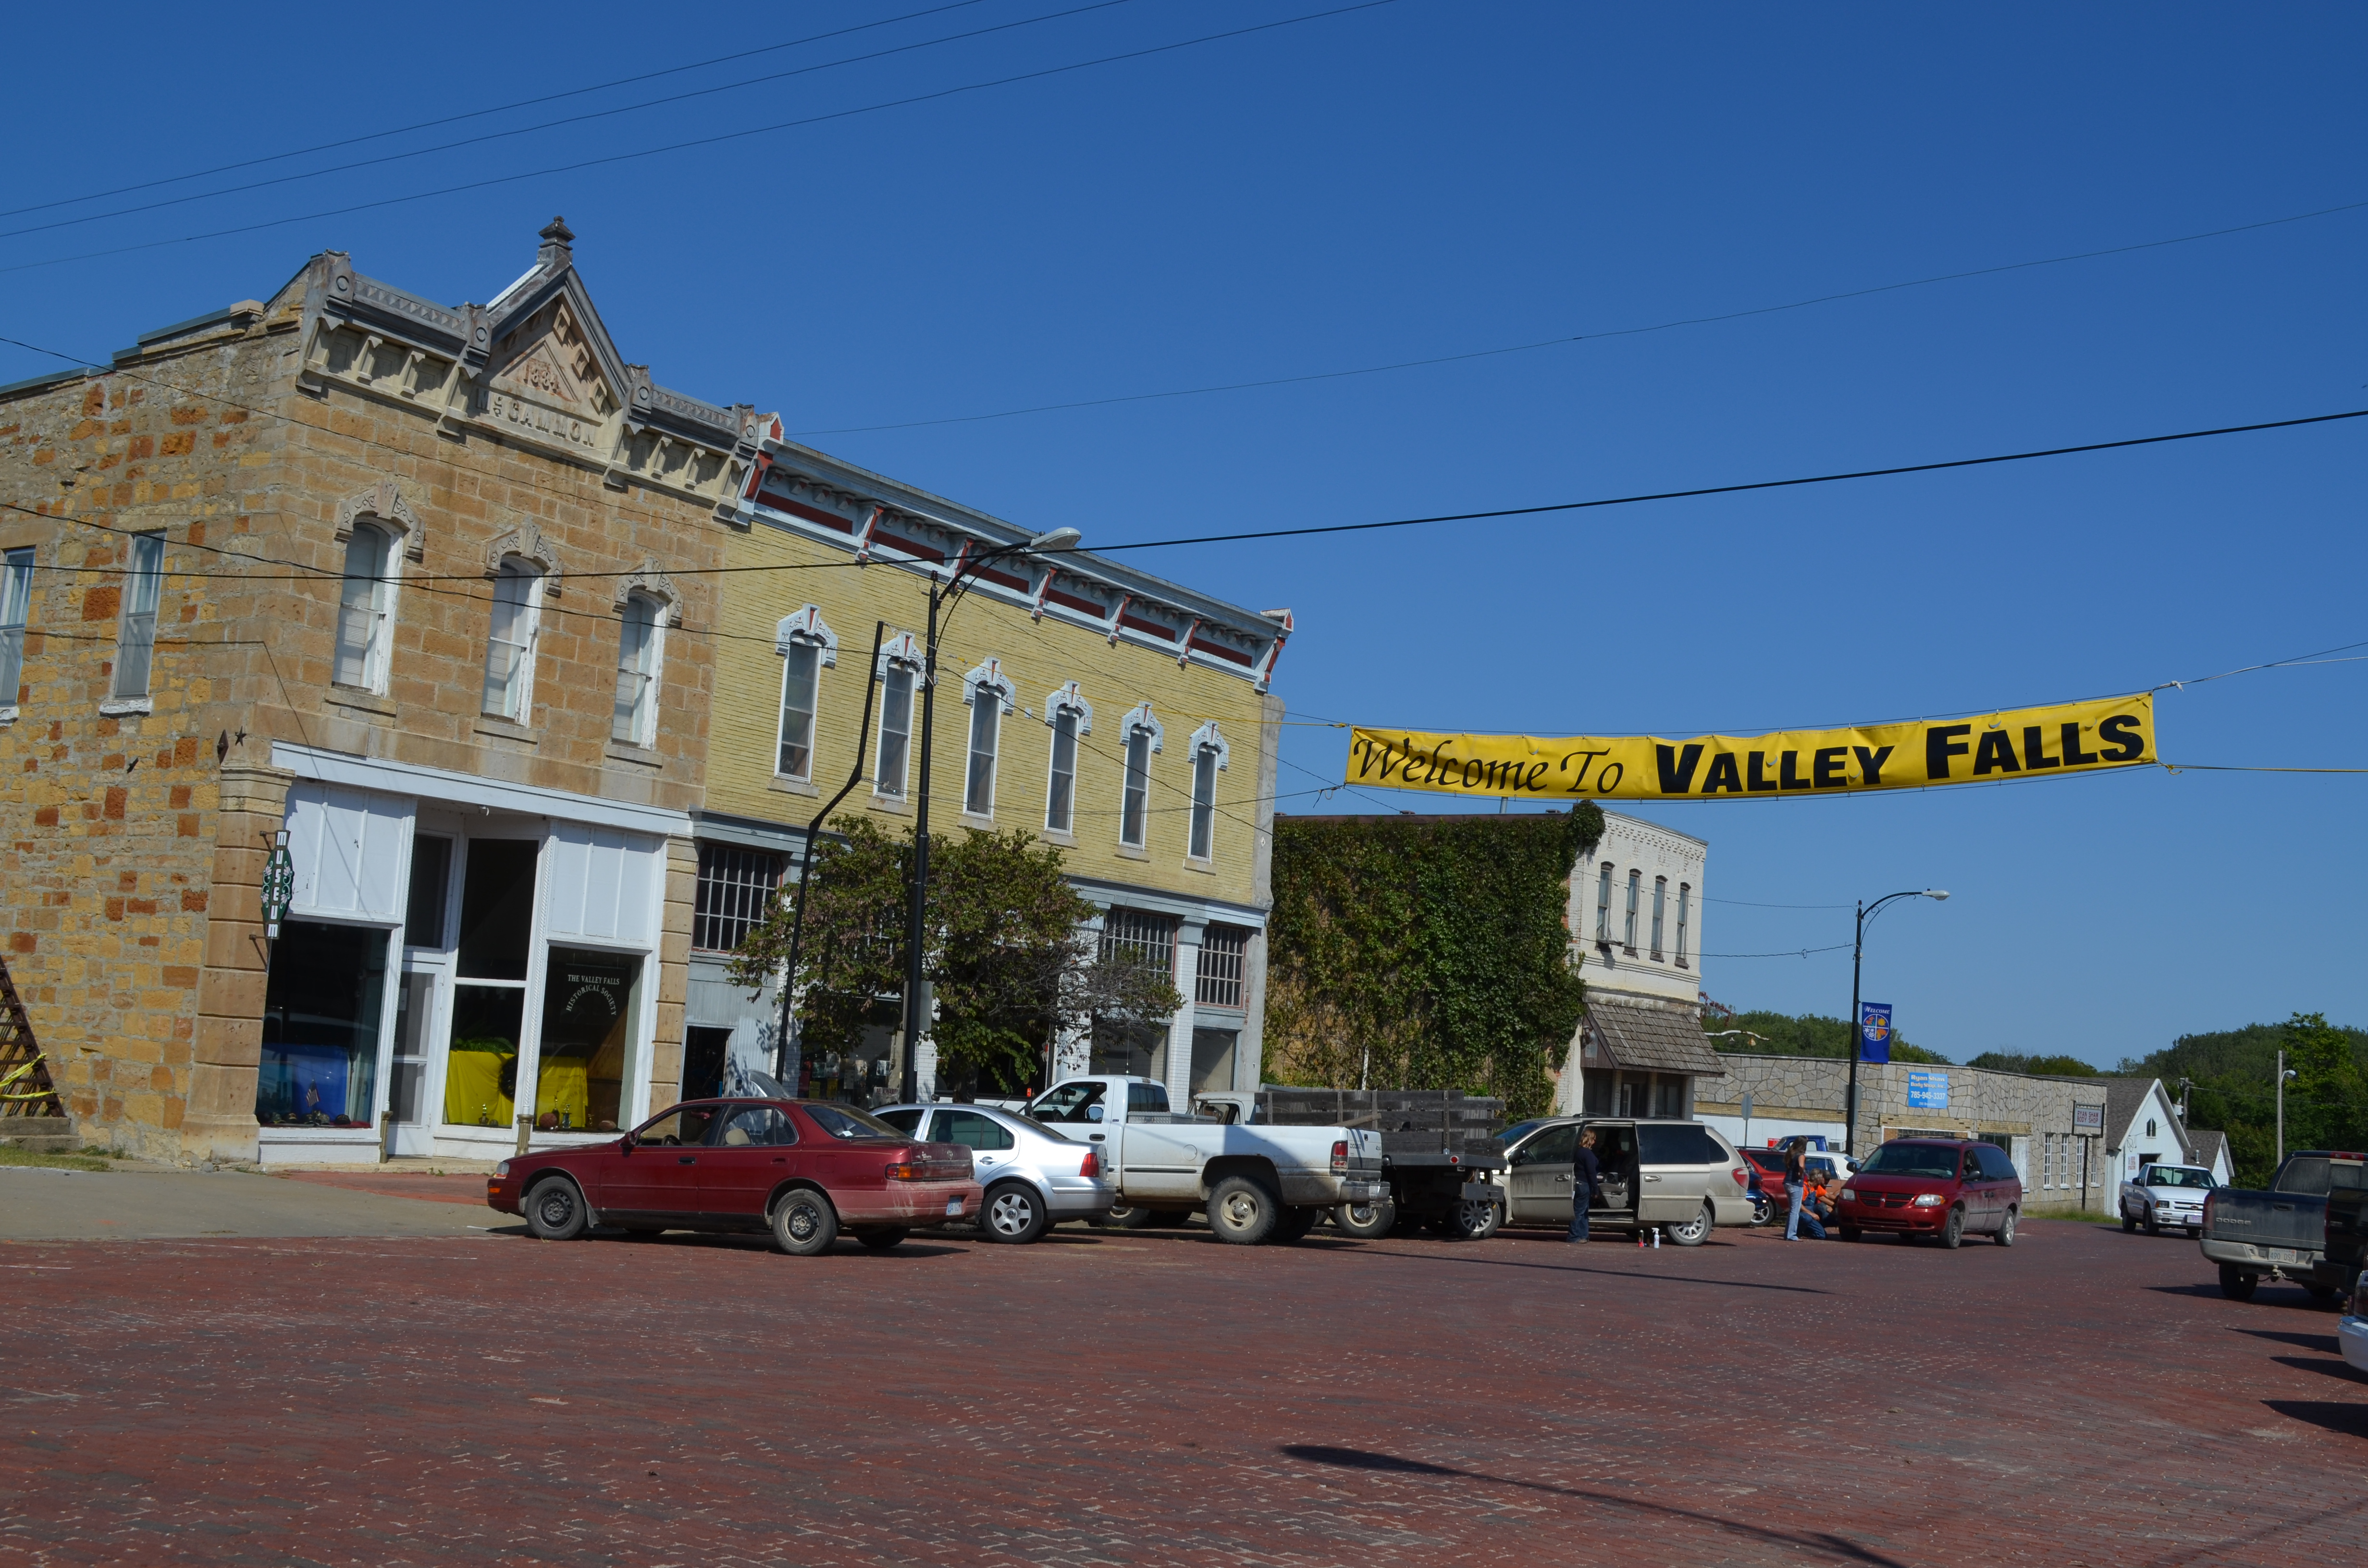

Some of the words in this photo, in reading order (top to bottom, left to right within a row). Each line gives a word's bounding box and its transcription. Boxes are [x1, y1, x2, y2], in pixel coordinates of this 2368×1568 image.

[1354, 737, 1549, 792] Welcome
[1560, 747, 1624, 794] To
[1656, 744, 1895, 794] VALLEY
[1926, 715, 2144, 779] FALLS
[267, 831, 287, 937] MUSEUM
[581, 975, 603, 984] VALLEY
[566, 984, 600, 1012] HISTORICAL
[601, 987, 617, 1015] SOCIETY
[1864, 1006, 1890, 1014] WELCOME
[1911, 1091, 1946, 1100] 785-945-3337
